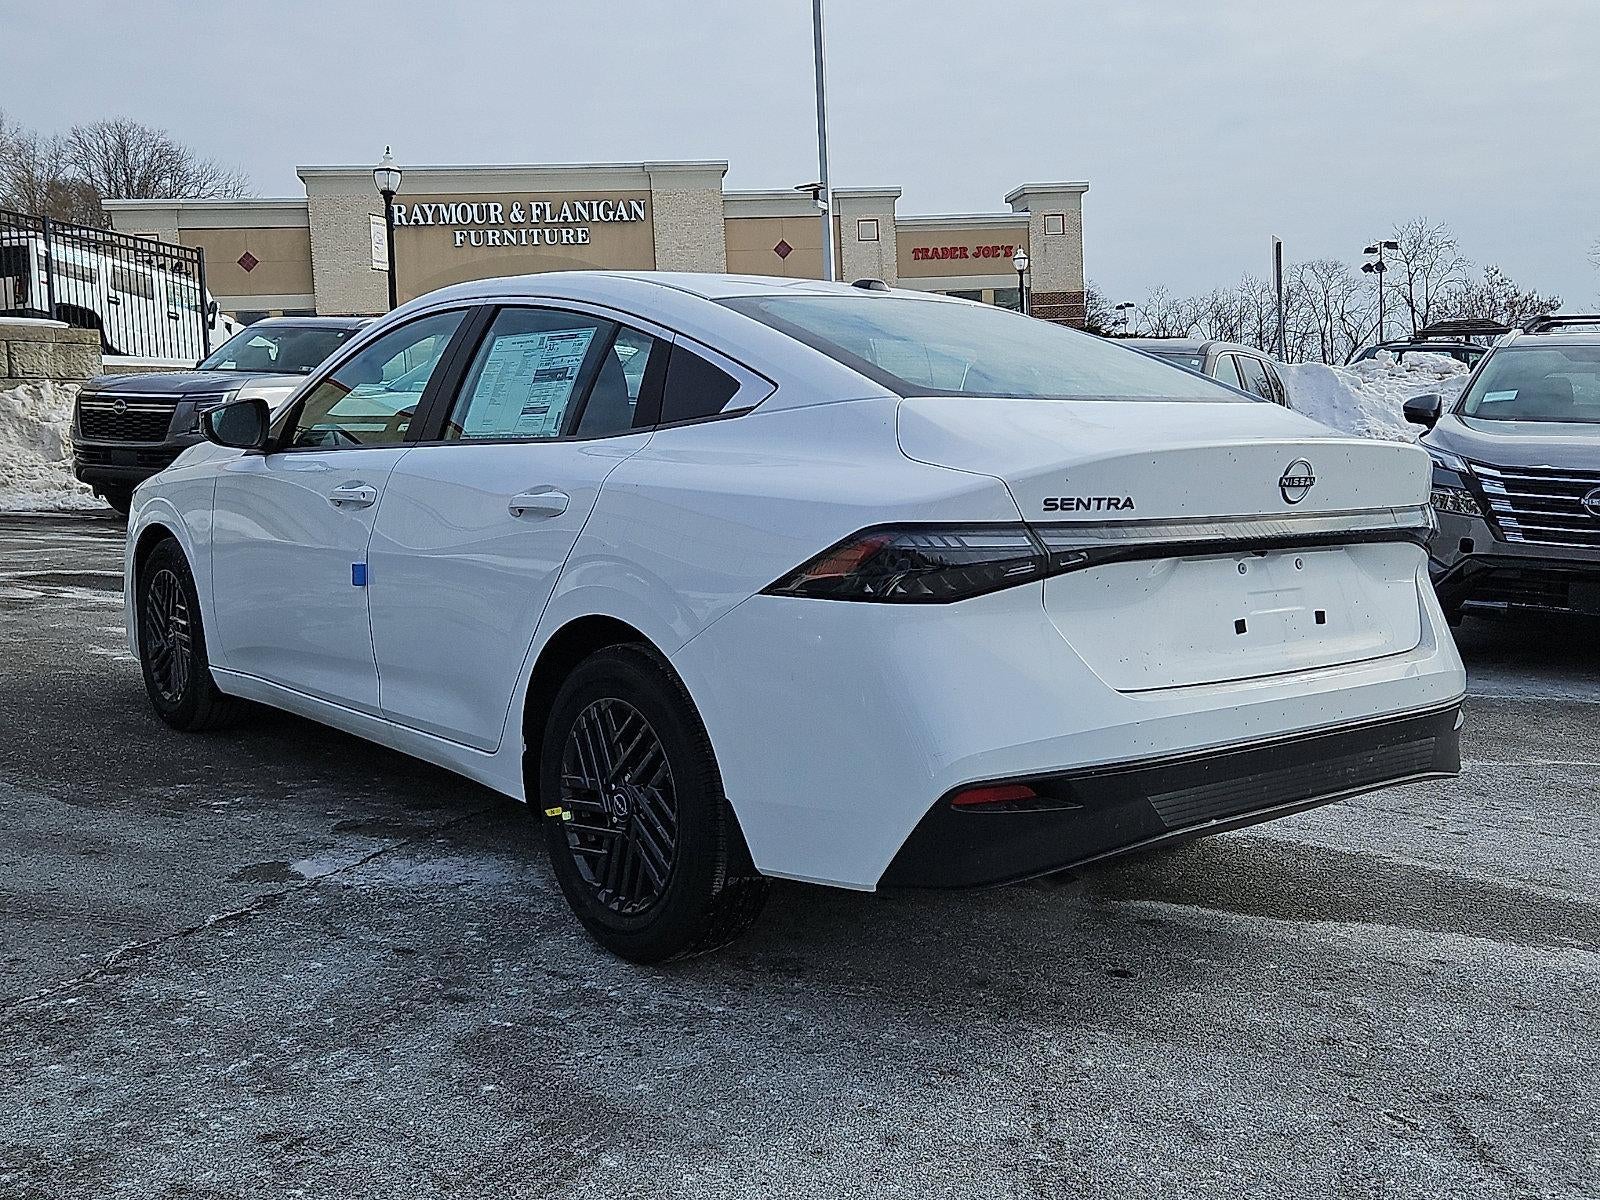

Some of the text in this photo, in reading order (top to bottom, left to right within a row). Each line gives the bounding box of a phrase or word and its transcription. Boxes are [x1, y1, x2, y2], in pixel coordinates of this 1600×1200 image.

[392, 200, 646, 226] RAYMOUR & FLANIGAN
[453, 227, 590, 247] FURNITURE
[912, 245, 1014, 260] TRADER JOE'S
[1042, 496, 1135, 512] SENTRA
